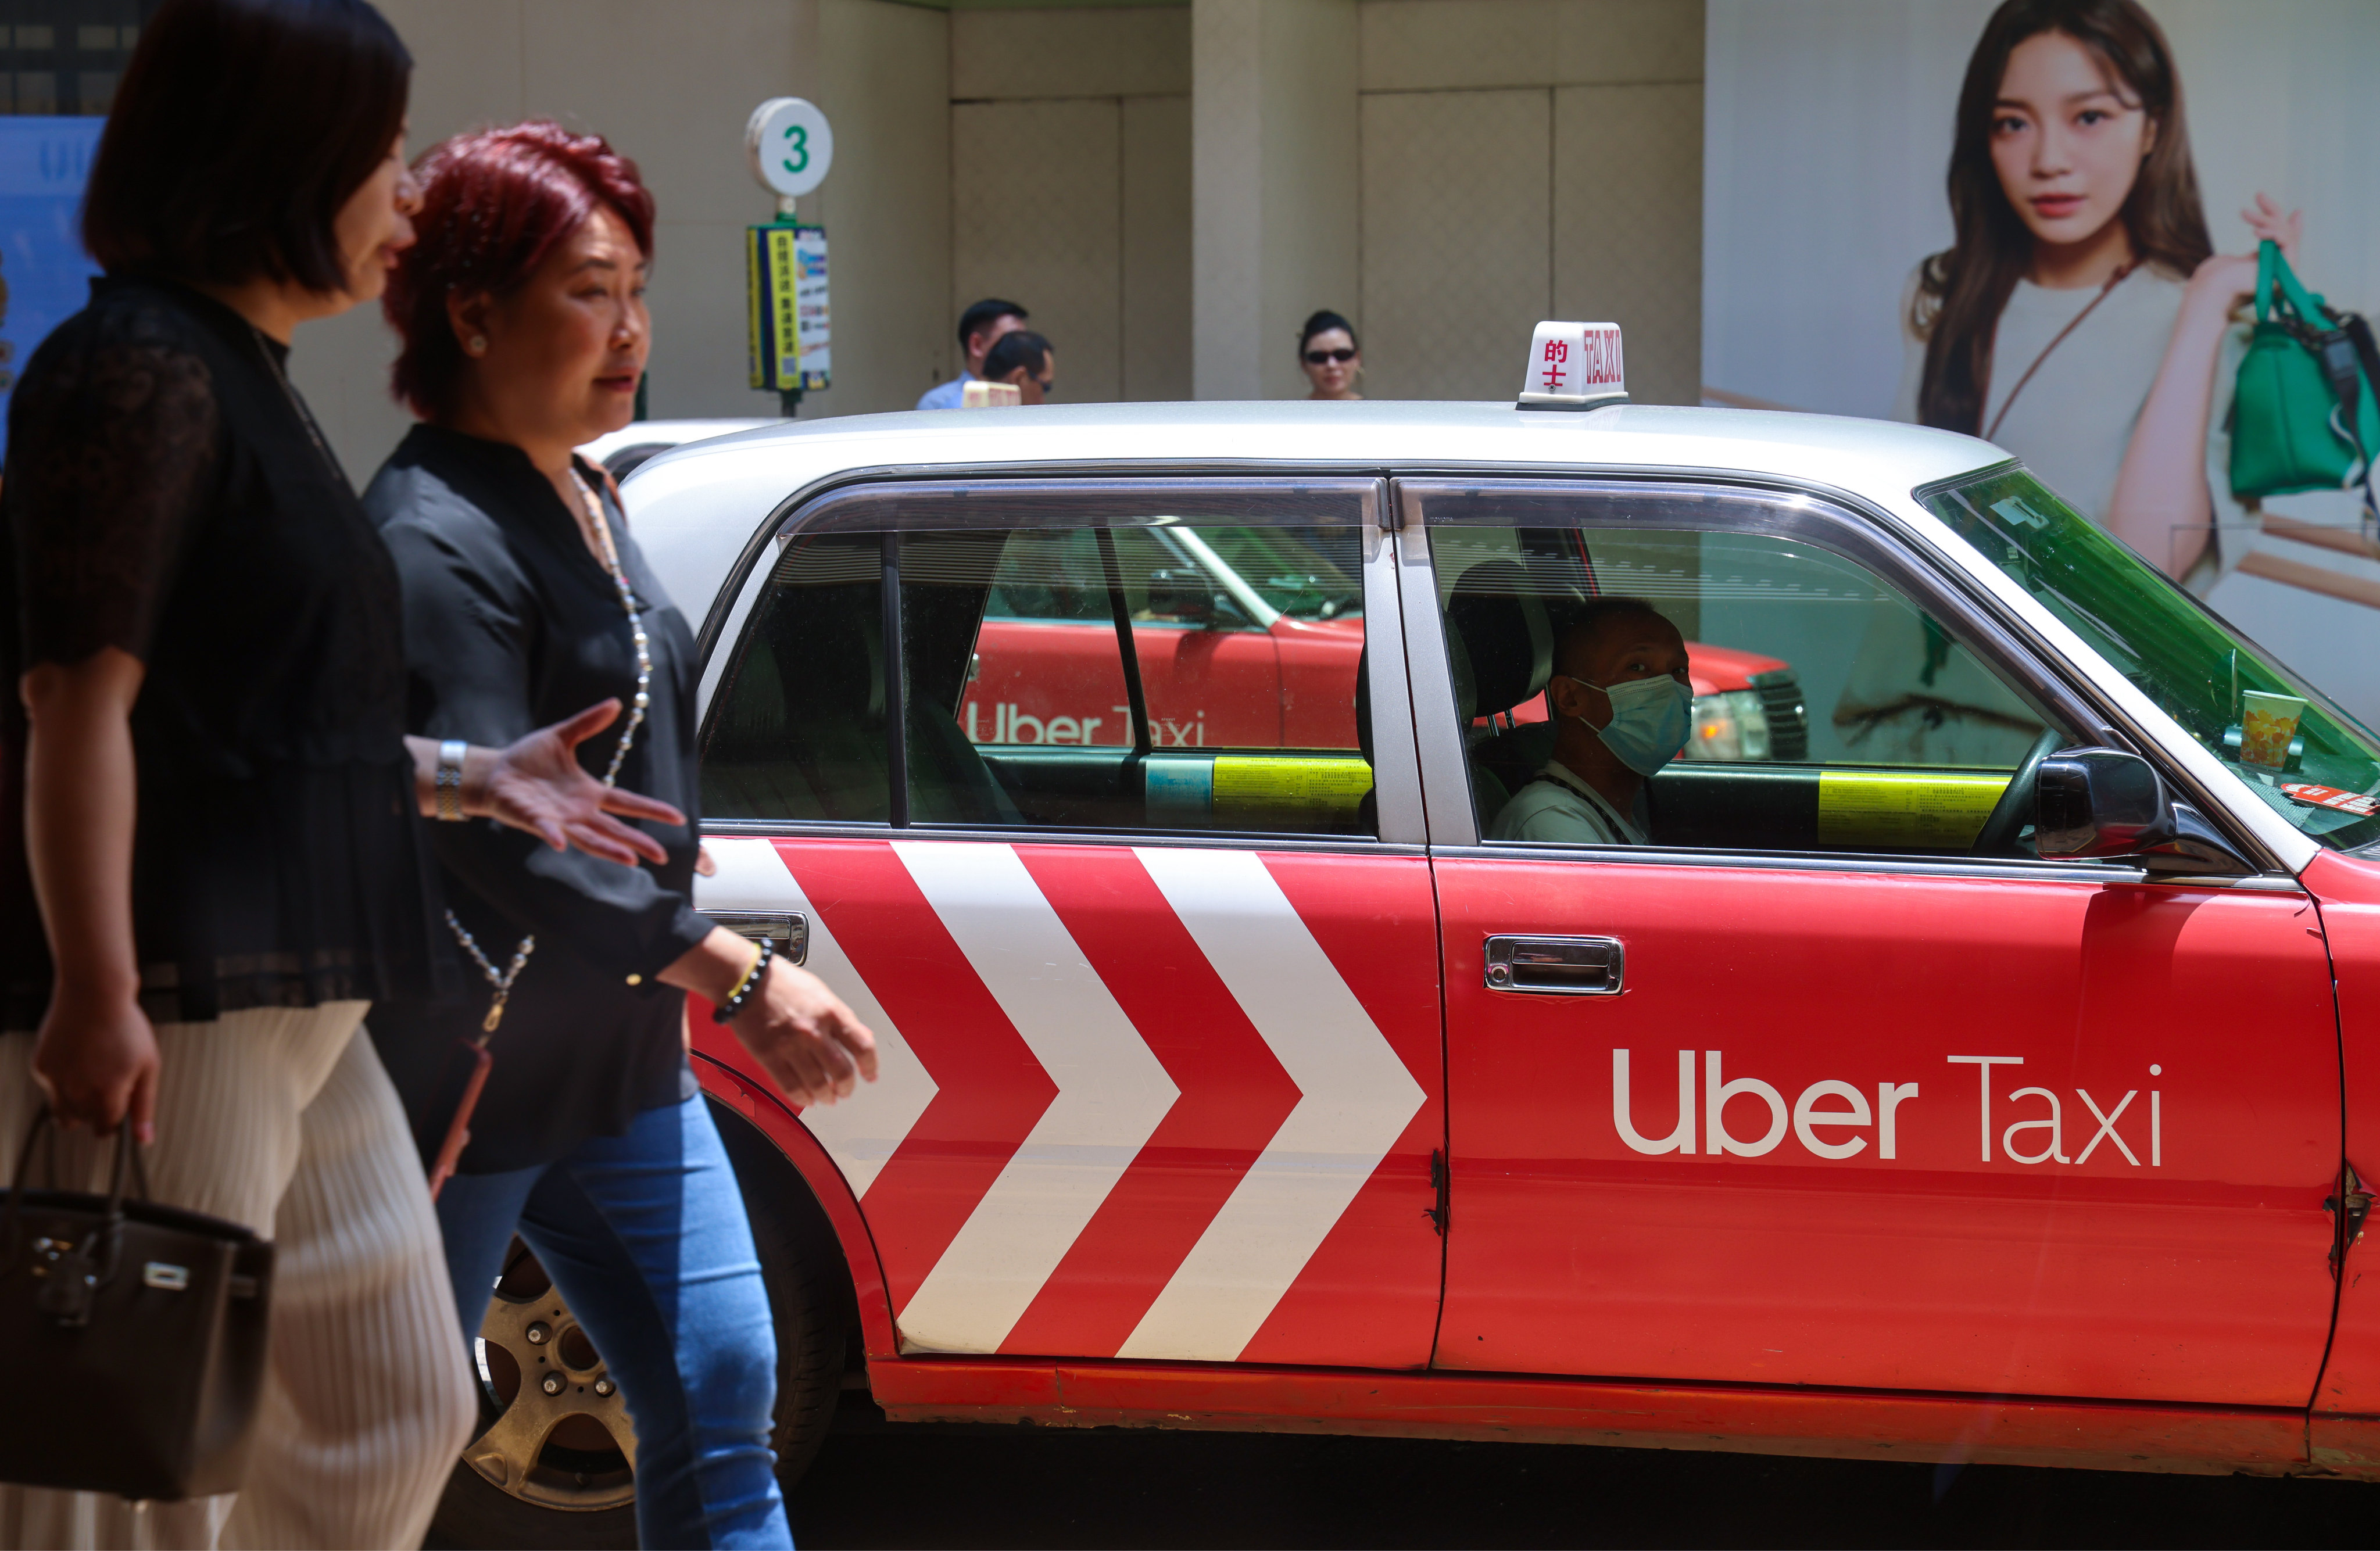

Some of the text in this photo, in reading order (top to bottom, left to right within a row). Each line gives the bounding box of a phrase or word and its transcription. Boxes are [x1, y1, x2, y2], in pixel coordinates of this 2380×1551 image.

[783, 126, 808, 173] 3
[1542, 339, 1568, 386] 的士
[1584, 329, 1622, 384] TAXI
[968, 701, 1102, 744] Uber
[1613, 1048, 2161, 1166] Uber Taxi
